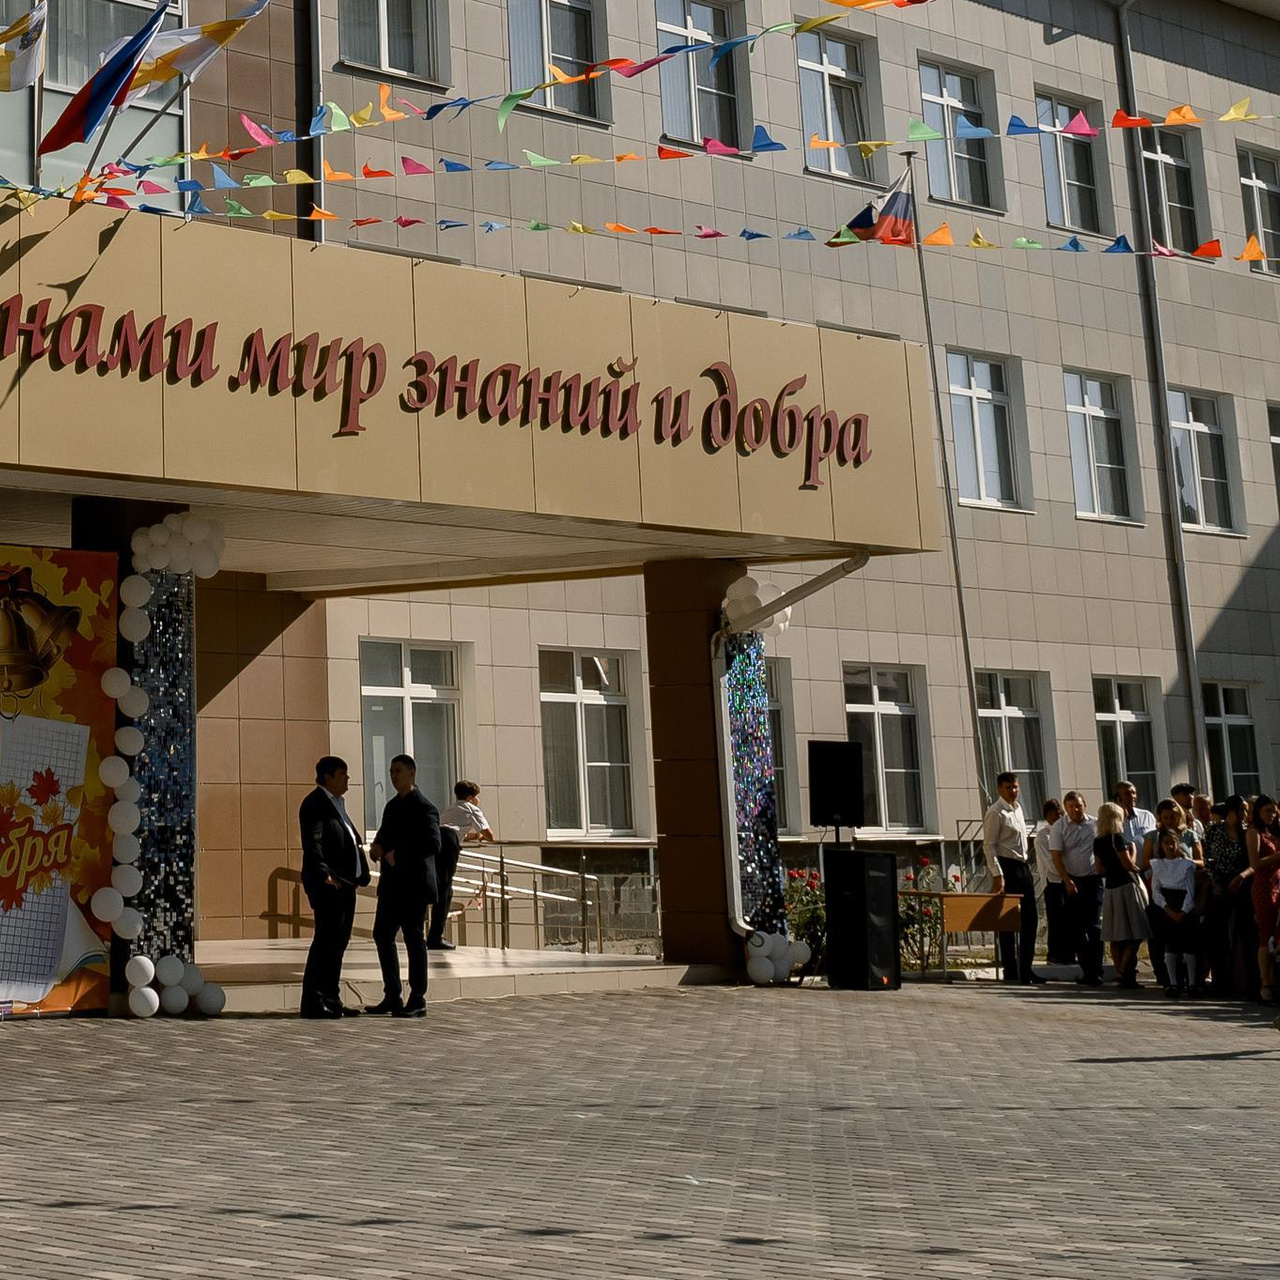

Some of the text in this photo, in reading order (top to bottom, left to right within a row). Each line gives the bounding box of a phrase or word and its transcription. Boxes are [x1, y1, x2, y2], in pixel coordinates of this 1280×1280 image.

[0, 292, 220, 382] нами
[237, 325, 387, 433] мир
[404, 354, 642, 438] знаний
[655, 384, 694, 444] и
[702, 360, 873, 487] добра
